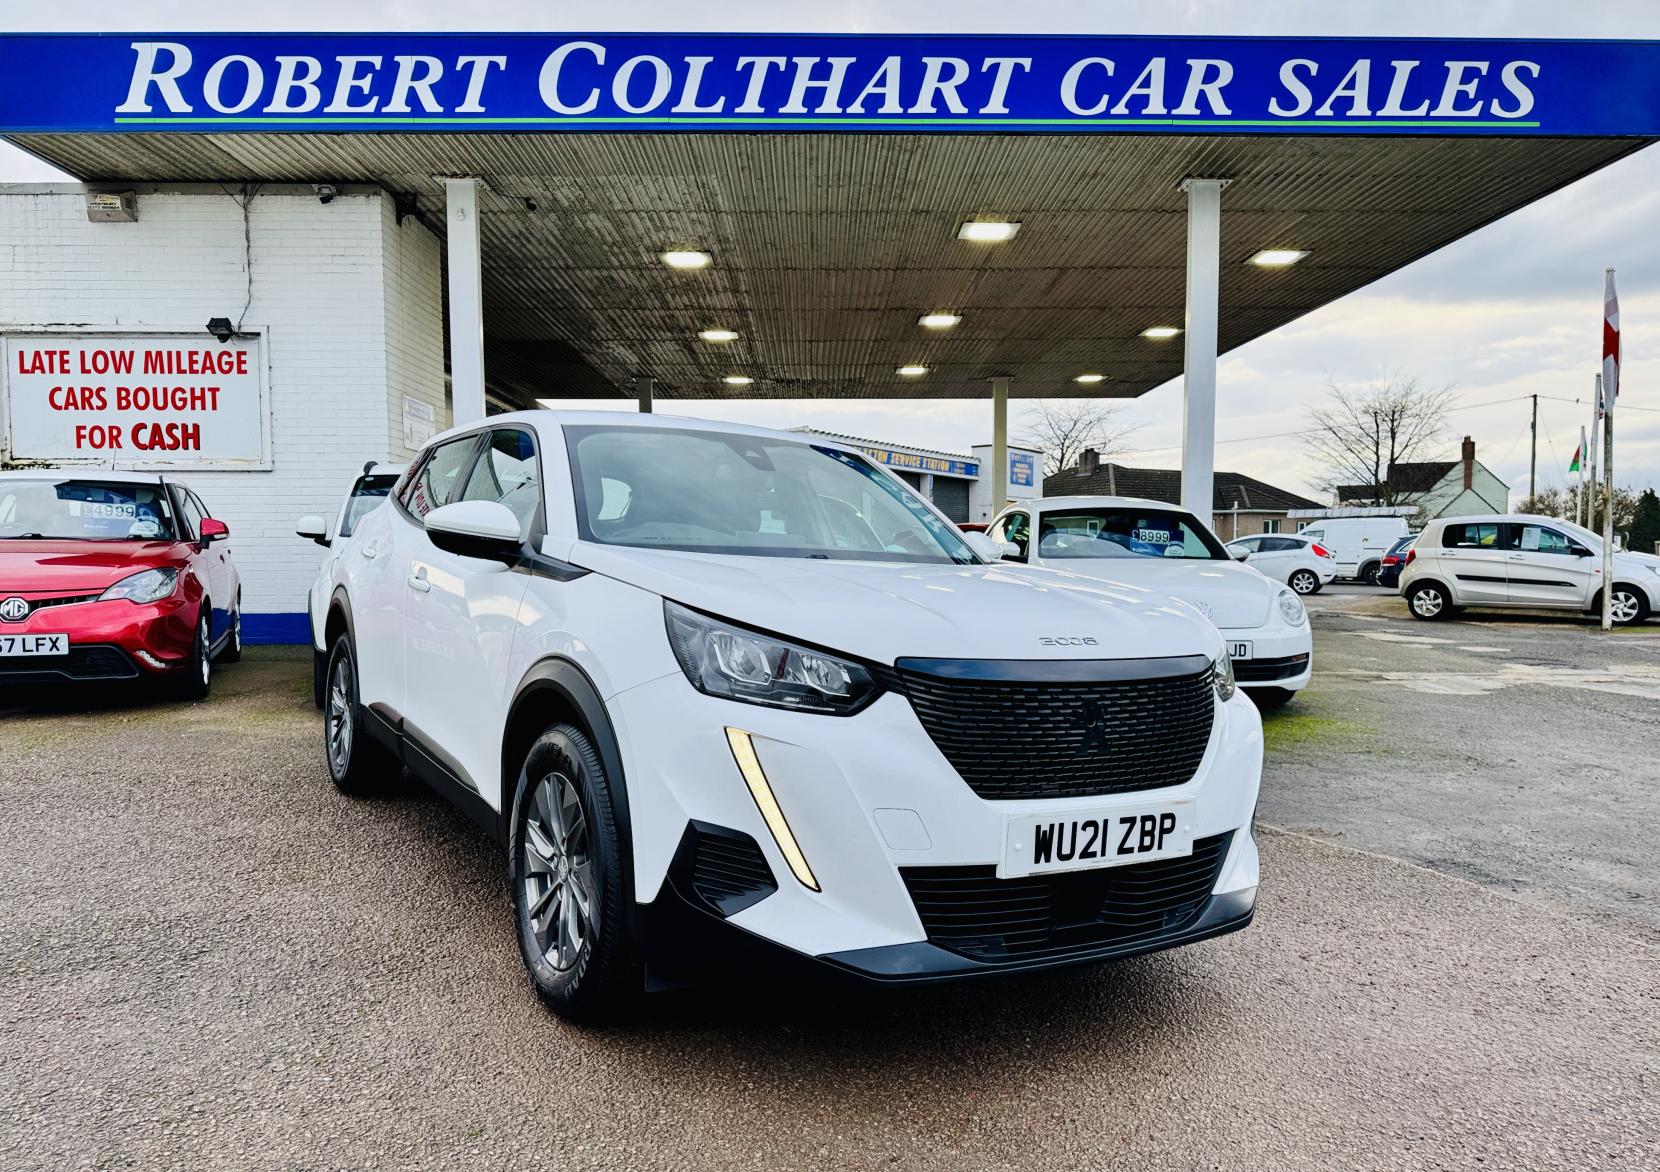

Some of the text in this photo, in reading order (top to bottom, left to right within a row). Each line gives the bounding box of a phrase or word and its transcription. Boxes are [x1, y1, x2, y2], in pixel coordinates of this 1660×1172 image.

[114, 41, 1540, 119] ROBERT COLTHART CAR SALES
[18, 350, 248, 375] LATE LOW MILEAGE
[48, 386, 220, 411] CARS BOUGHT
[75, 422, 201, 451] FOR CASH
[3, 600, 25, 617] MG
[0, 636, 61, 653] 7 LFX
[1034, 813, 1176, 864] WU21 ZBP
